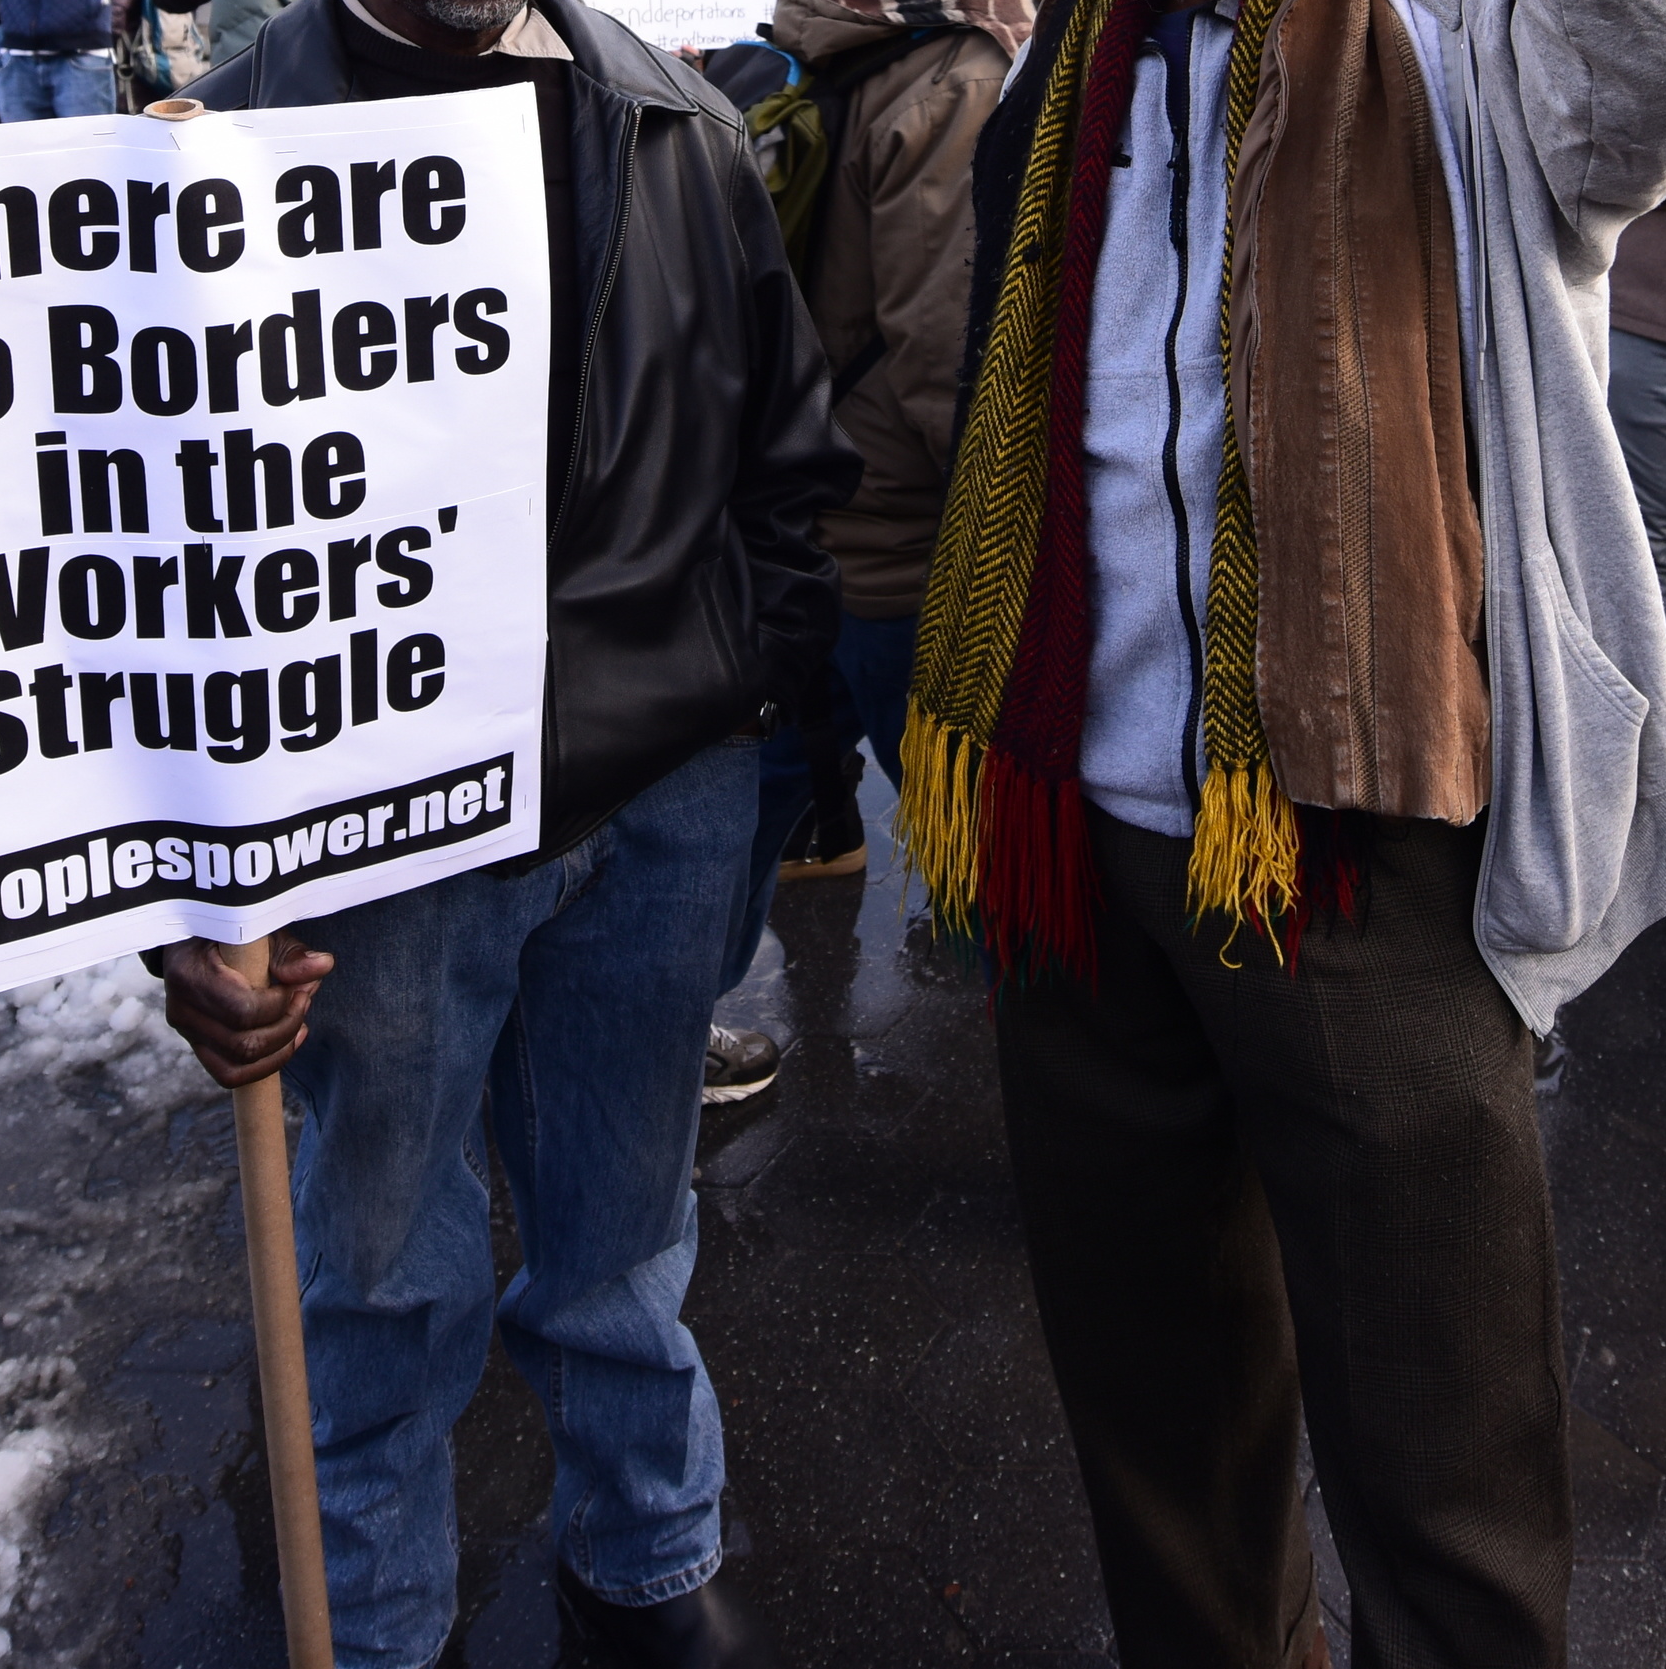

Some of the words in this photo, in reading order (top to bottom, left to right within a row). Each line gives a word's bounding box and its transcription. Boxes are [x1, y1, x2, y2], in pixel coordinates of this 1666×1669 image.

[276, 155, 466, 258] are
[48, 288, 510, 417] Borders
[35, 431, 150, 537] in
[176, 429, 366, 533] the
